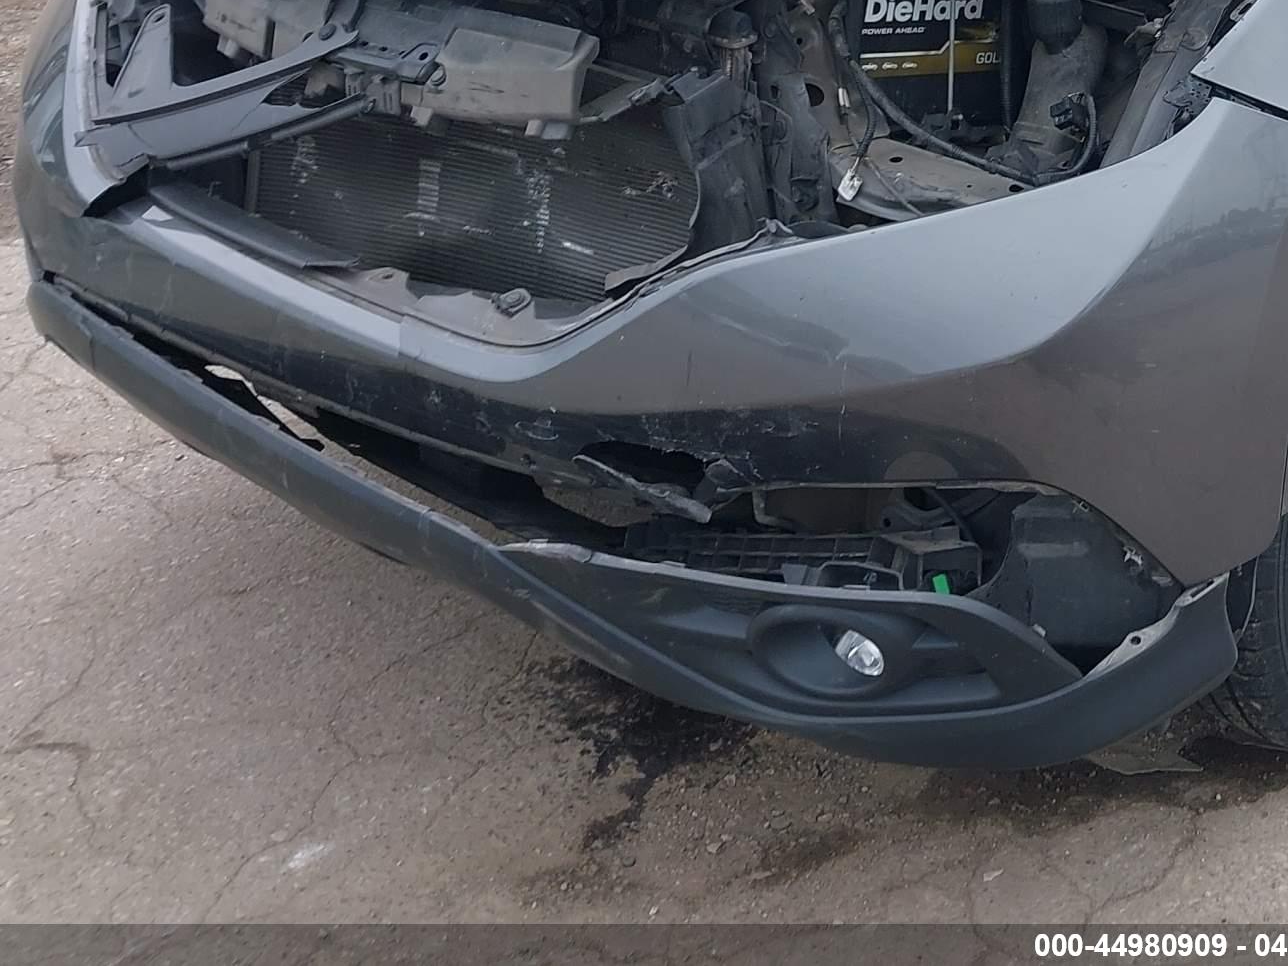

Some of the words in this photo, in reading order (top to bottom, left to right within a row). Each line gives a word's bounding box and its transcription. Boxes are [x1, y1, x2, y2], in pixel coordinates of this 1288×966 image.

[861, 27, 893, 35] POWER
[895, 26, 925, 34] AHEAD
[975, 51, 1001, 64] GOL
